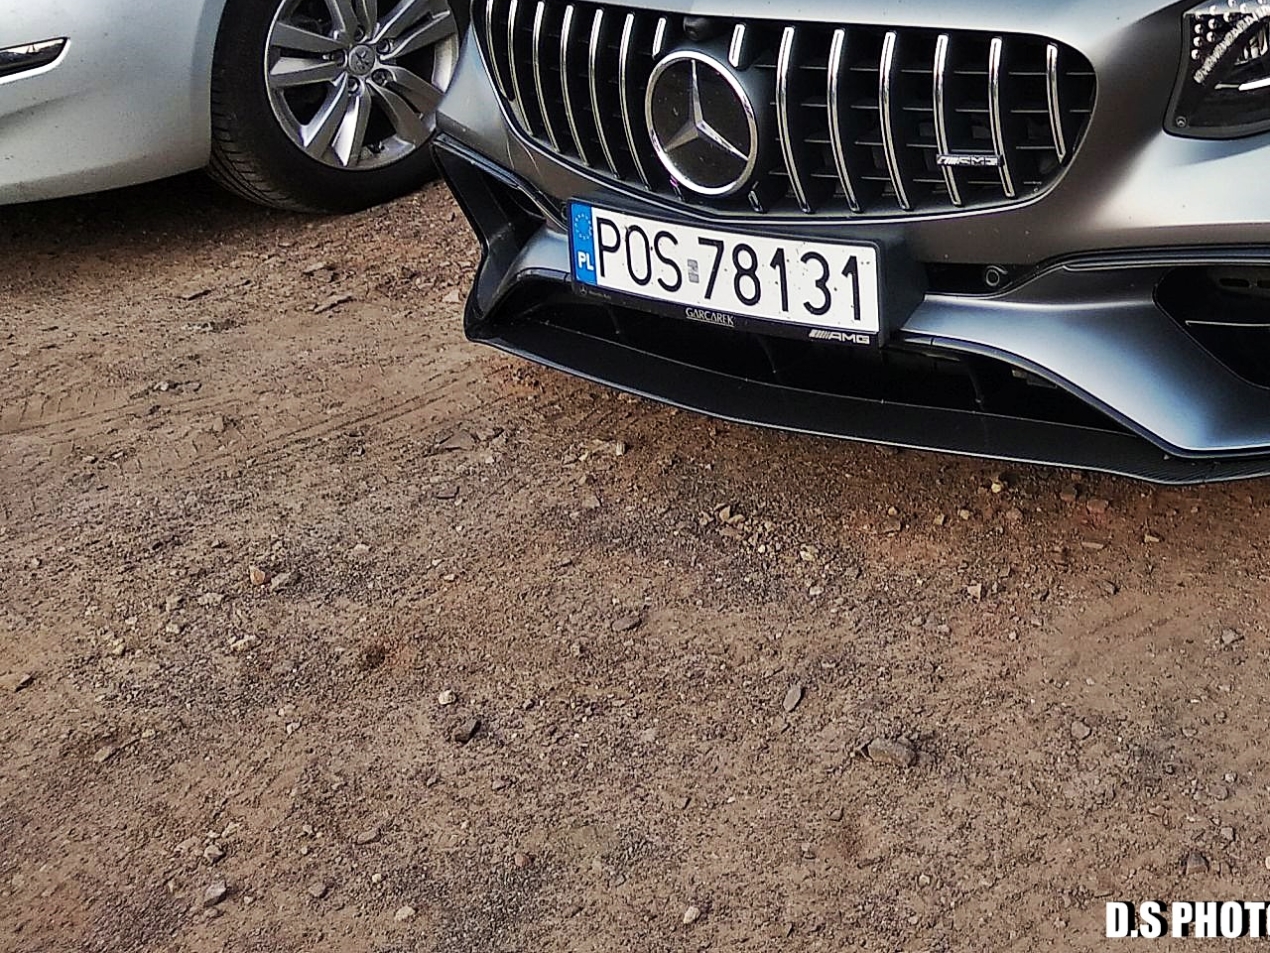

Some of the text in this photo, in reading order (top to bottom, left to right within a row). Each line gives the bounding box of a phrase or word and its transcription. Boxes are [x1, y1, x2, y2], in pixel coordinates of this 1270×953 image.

[578, 251, 595, 271] PL
[596, 216, 861, 321] POS 78131
[685, 307, 735, 328] GARCAREK
